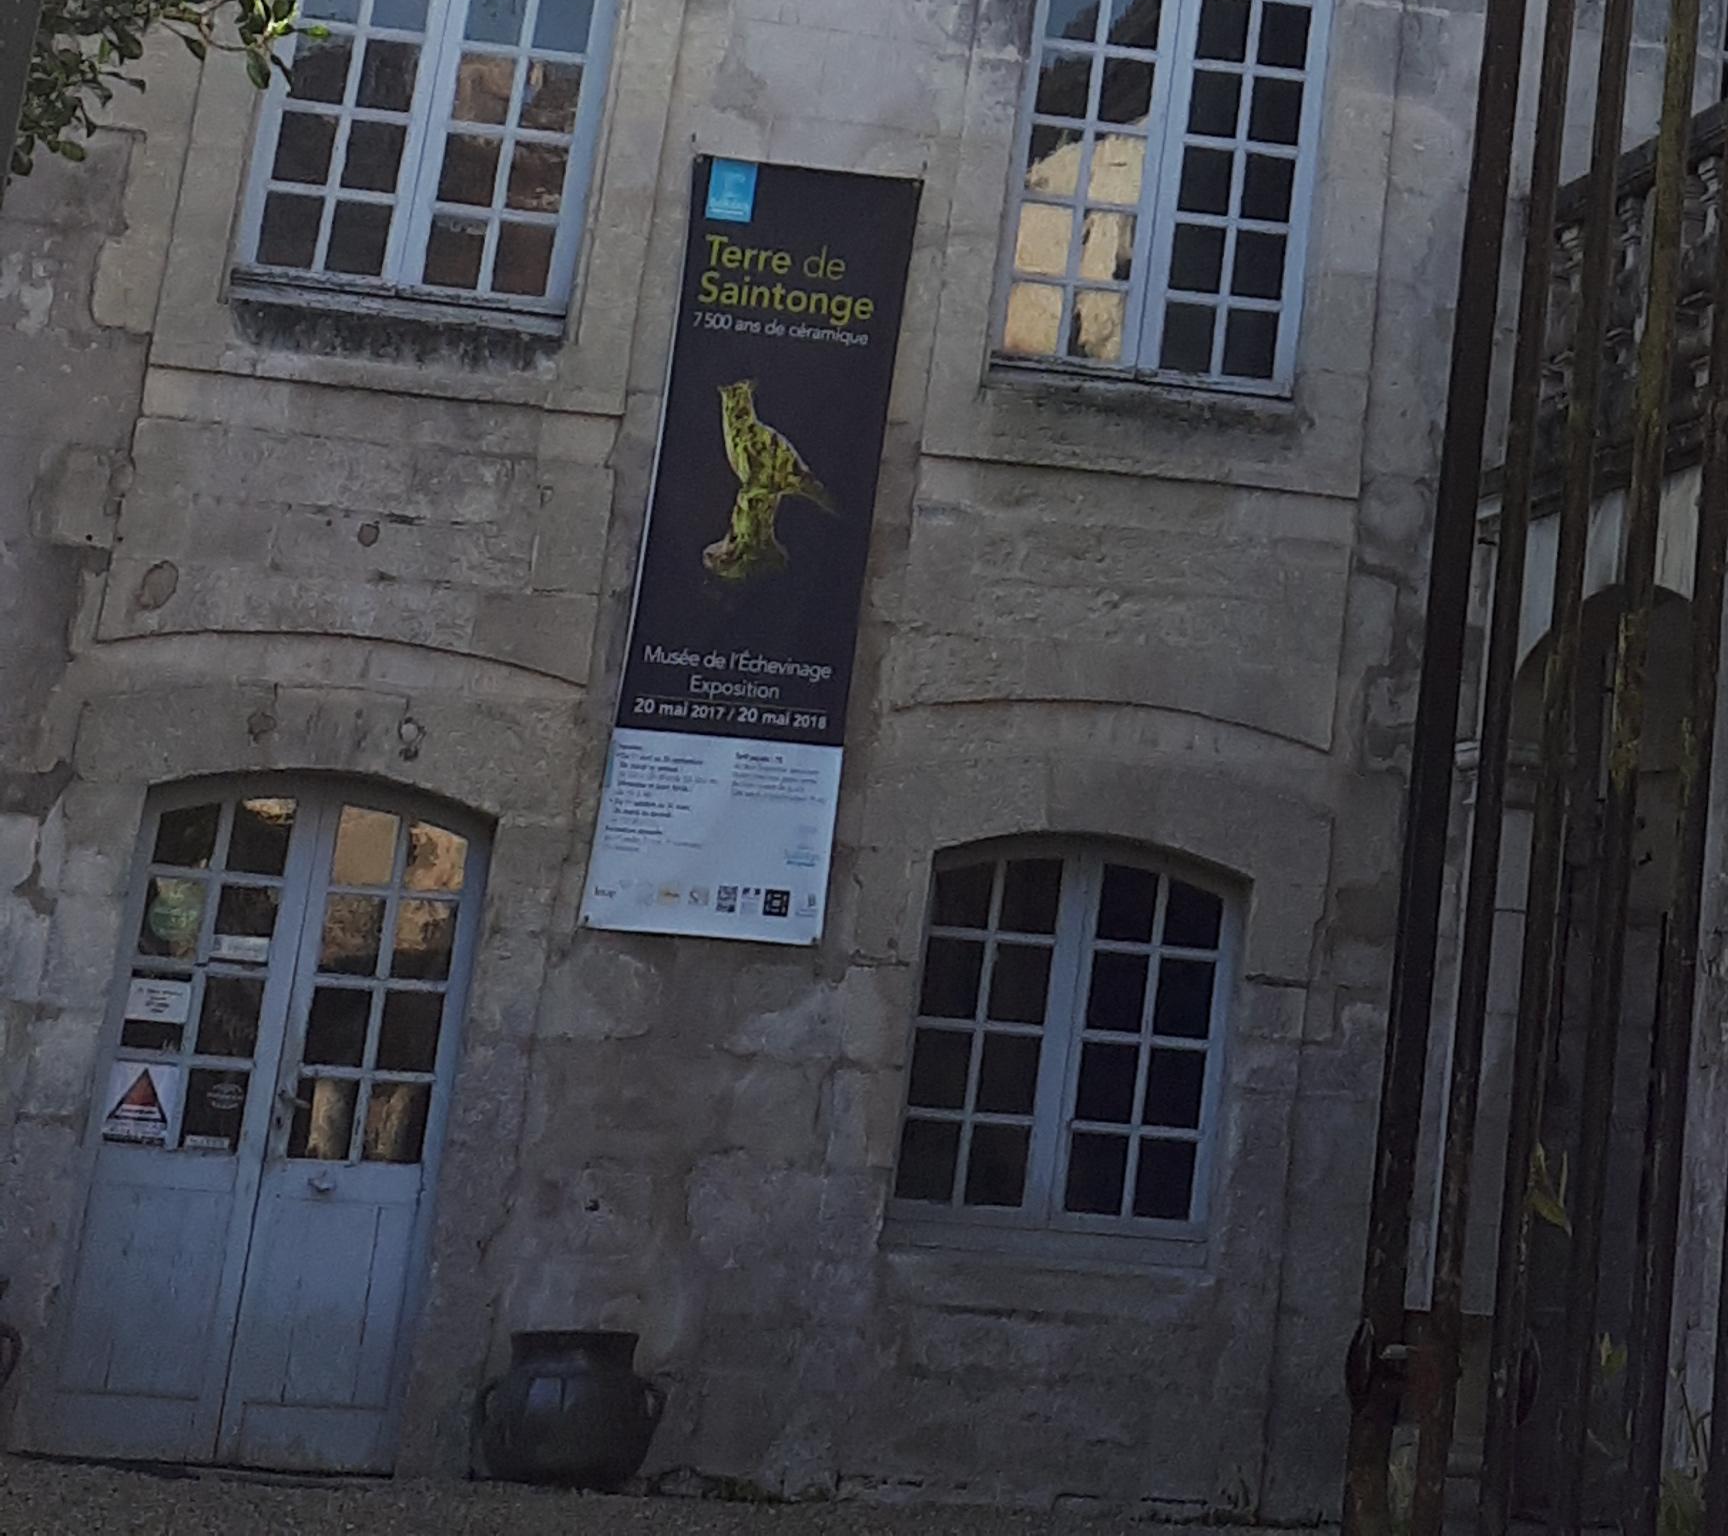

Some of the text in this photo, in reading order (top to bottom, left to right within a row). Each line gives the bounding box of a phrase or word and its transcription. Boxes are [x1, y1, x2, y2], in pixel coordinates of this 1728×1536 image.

[705, 234, 846, 280] Terre de
[698, 270, 874, 326] Saintonge
[734, 319, 760, 333] ans
[764, 319, 784, 335] de
[788, 321, 868, 346] céramique
[643, 645, 699, 667] Musée
[703, 648, 725, 669] de
[689, 675, 780, 699] Exposition
[634, 698, 655, 713] 20
[659, 702, 687, 717] mai
[690, 705, 725, 721] 2017
[737, 707, 757, 722] 20
[762, 710, 790, 725] mai
[793, 714, 827, 729] 2018
